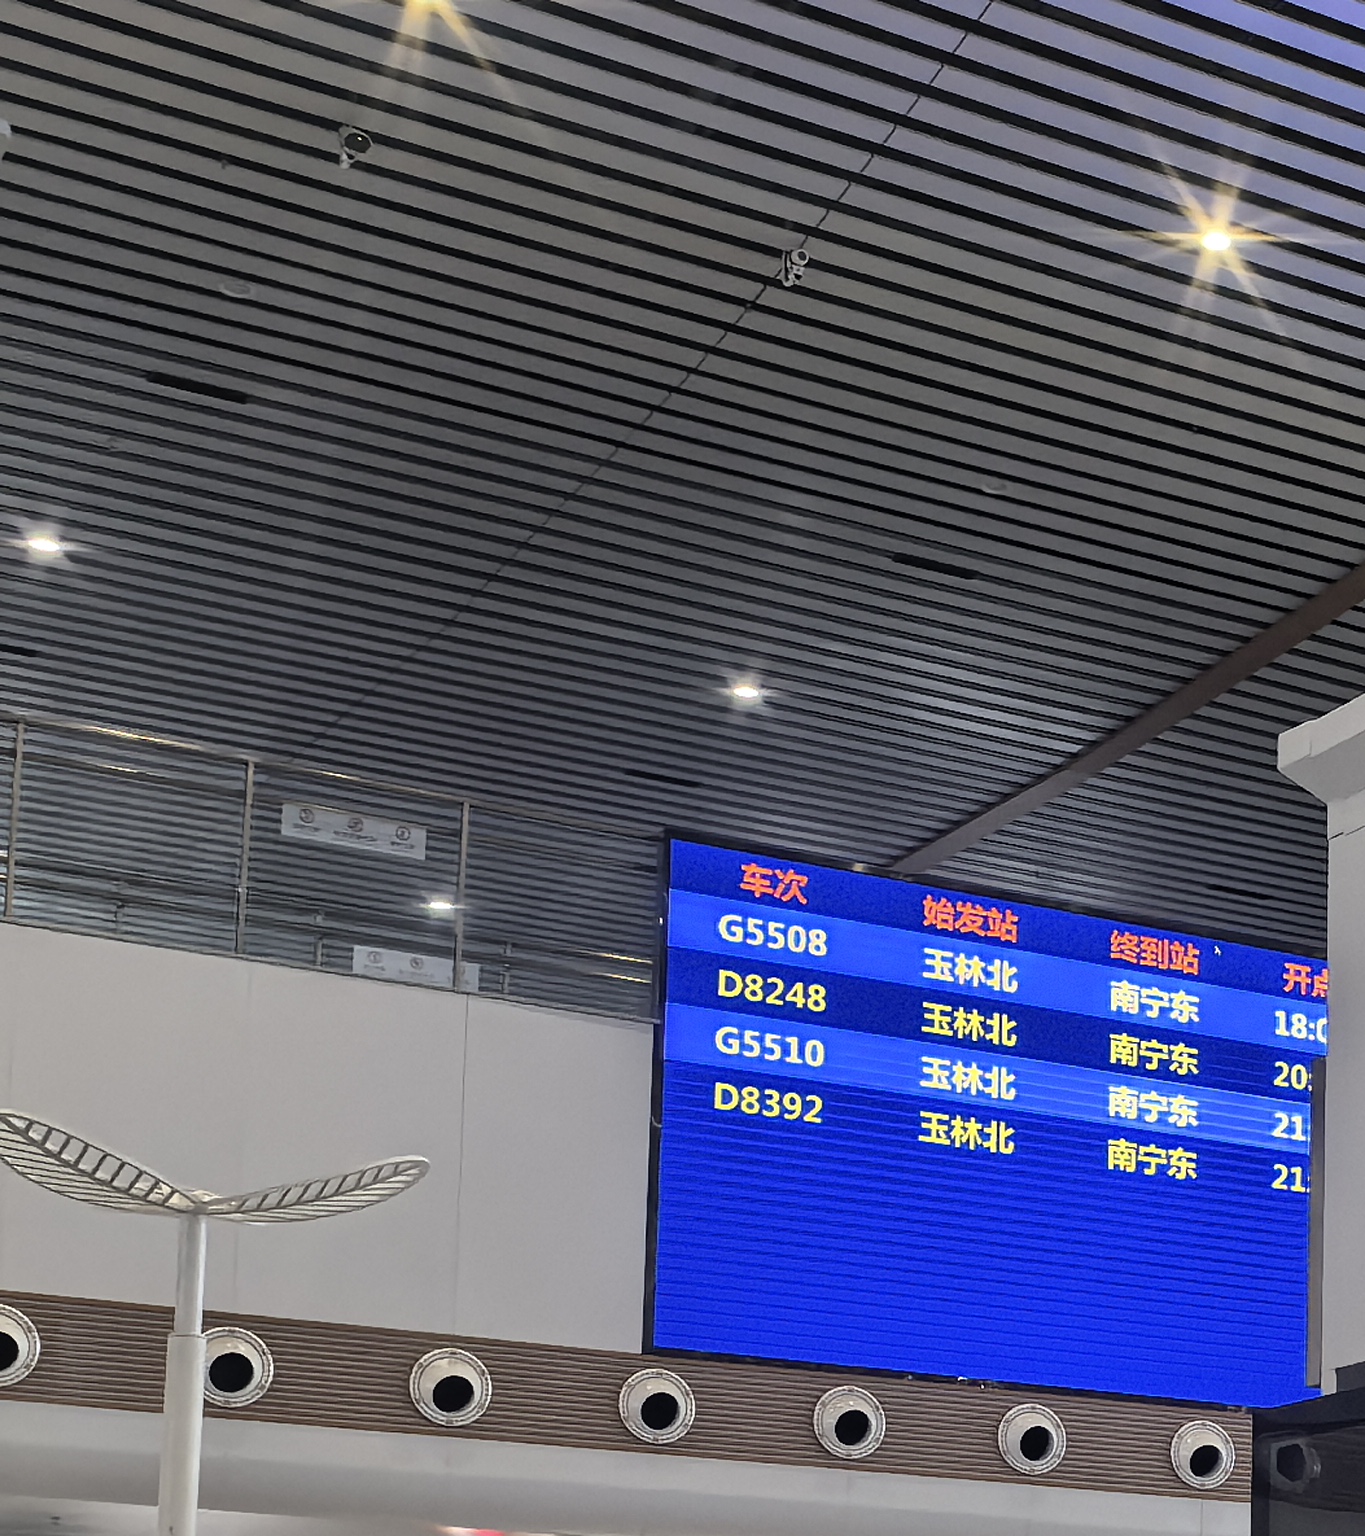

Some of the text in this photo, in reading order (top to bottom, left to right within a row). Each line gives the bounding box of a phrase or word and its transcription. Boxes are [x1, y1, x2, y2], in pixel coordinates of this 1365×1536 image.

[717, 914, 828, 957] G5508
[922, 948, 1019, 993] 玉林北
[1110, 979, 1200, 1024] 南宁东
[739, 862, 809, 905] 车次
[922, 894, 1019, 944] 始发站
[1110, 930, 1200, 976] 终到站
[717, 969, 827, 1012] D8248
[921, 1002, 1018, 1047] 玉林北
[1109, 1033, 1200, 1076] 南宁东
[714, 1026, 1310, 1142] G5510 玉林北 南宁东 21
[714, 1081, 823, 1124] D8392
[918, 1110, 1015, 1155] 玉林北
[1107, 1137, 1198, 1180] 南宁东
